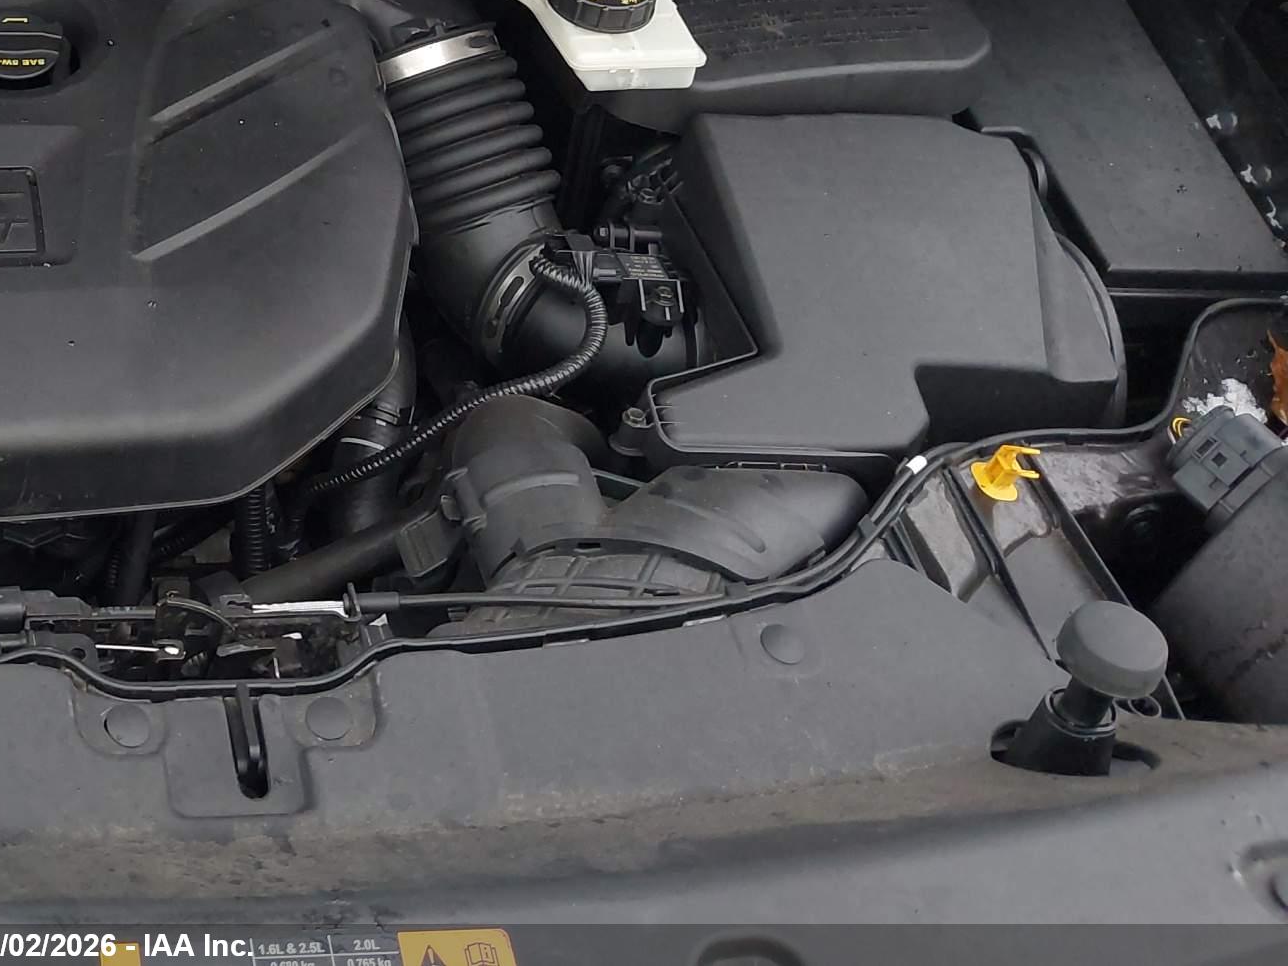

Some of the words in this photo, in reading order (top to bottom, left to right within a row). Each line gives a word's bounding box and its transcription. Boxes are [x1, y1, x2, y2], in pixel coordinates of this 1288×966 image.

[258, 944, 284, 955] 1.6L
[286, 943, 297, 954] &
[298, 942, 325, 954] 2.5L
[353, 939, 381, 951] 2.0L
